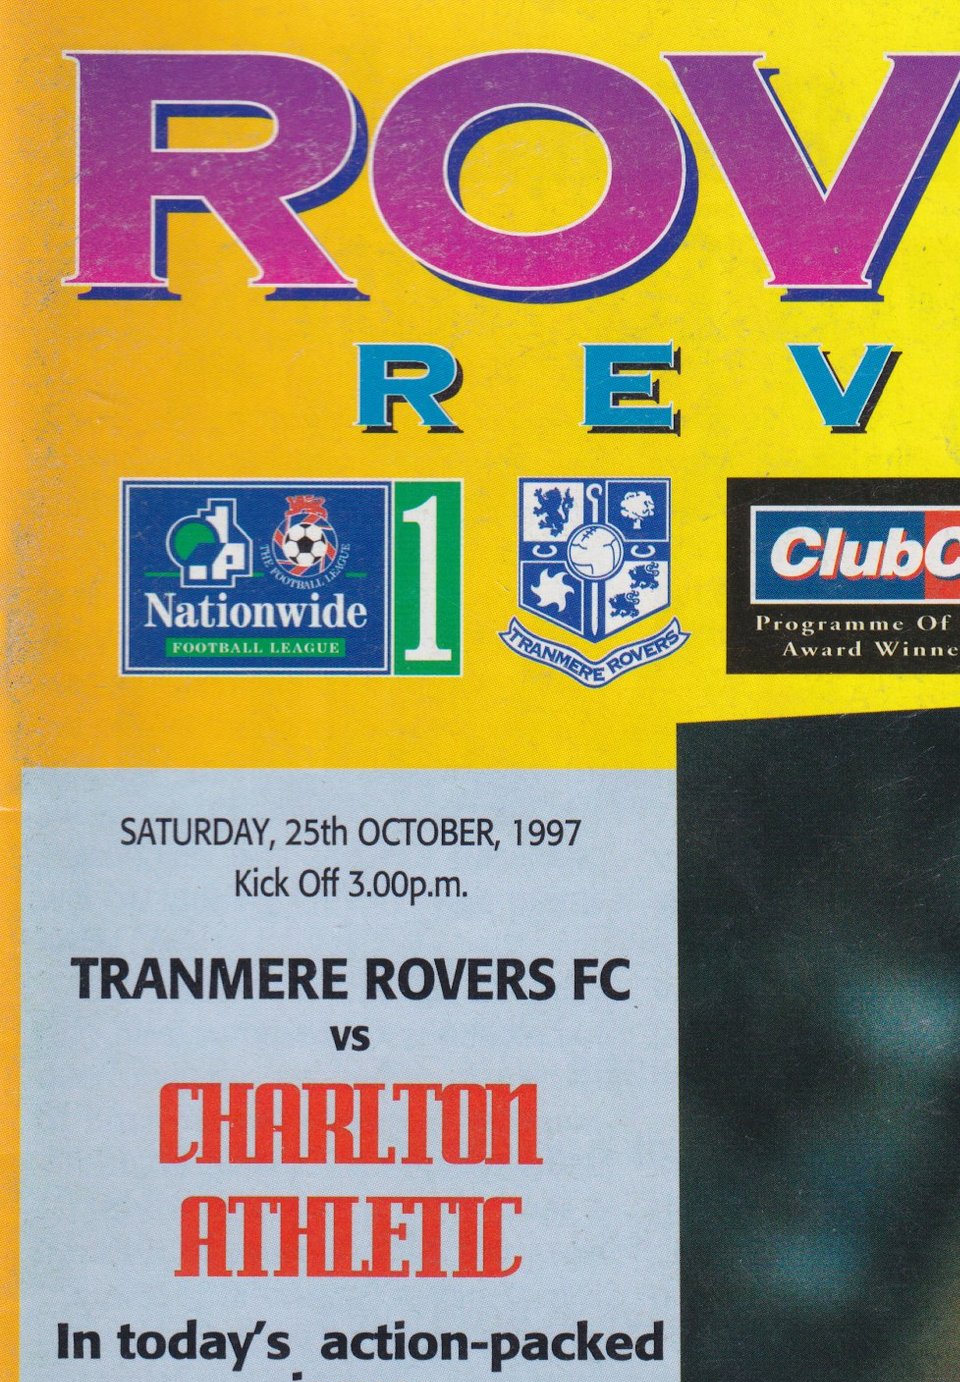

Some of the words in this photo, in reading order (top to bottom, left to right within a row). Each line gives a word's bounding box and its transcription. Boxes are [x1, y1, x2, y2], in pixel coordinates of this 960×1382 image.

[261, 544, 273, 569] THE
[270, 566, 325, 590] FOOTBALL
[325, 543, 351, 584] LEAGUE
[403, 496, 452, 661] 1
[144, 593, 367, 628] Nationwide
[756, 614, 904, 636] Programme
[916, 614, 952, 632] Of
[172, 642, 263, 654] FOOTBALL
[270, 642, 340, 654] LEAGUE
[509, 626, 605, 682] TRANMERE
[606, 629, 679, 674] ROVERS
[782, 641, 862, 657] Award
[121, 817, 275, 850] SATURDAY,
[286, 815, 347, 845] 25th
[359, 818, 500, 851] OCTOBER,
[514, 819, 581, 846] 1997
[236, 867, 289, 897] Kick
[299, 867, 339, 897] Off
[349, 871, 467, 906] 3.00p.m.
[71, 957, 348, 999] TRANMERE
[366, 958, 556, 1001] ROVERS
[574, 958, 630, 1001] FC
[330, 1026, 370, 1051] vs
[175, 1196, 522, 1277] ATHLETIC
[58, 1323, 100, 1359] In
[117, 1319, 290, 1371] today's
[321, 1320, 663, 1372] action-packed
